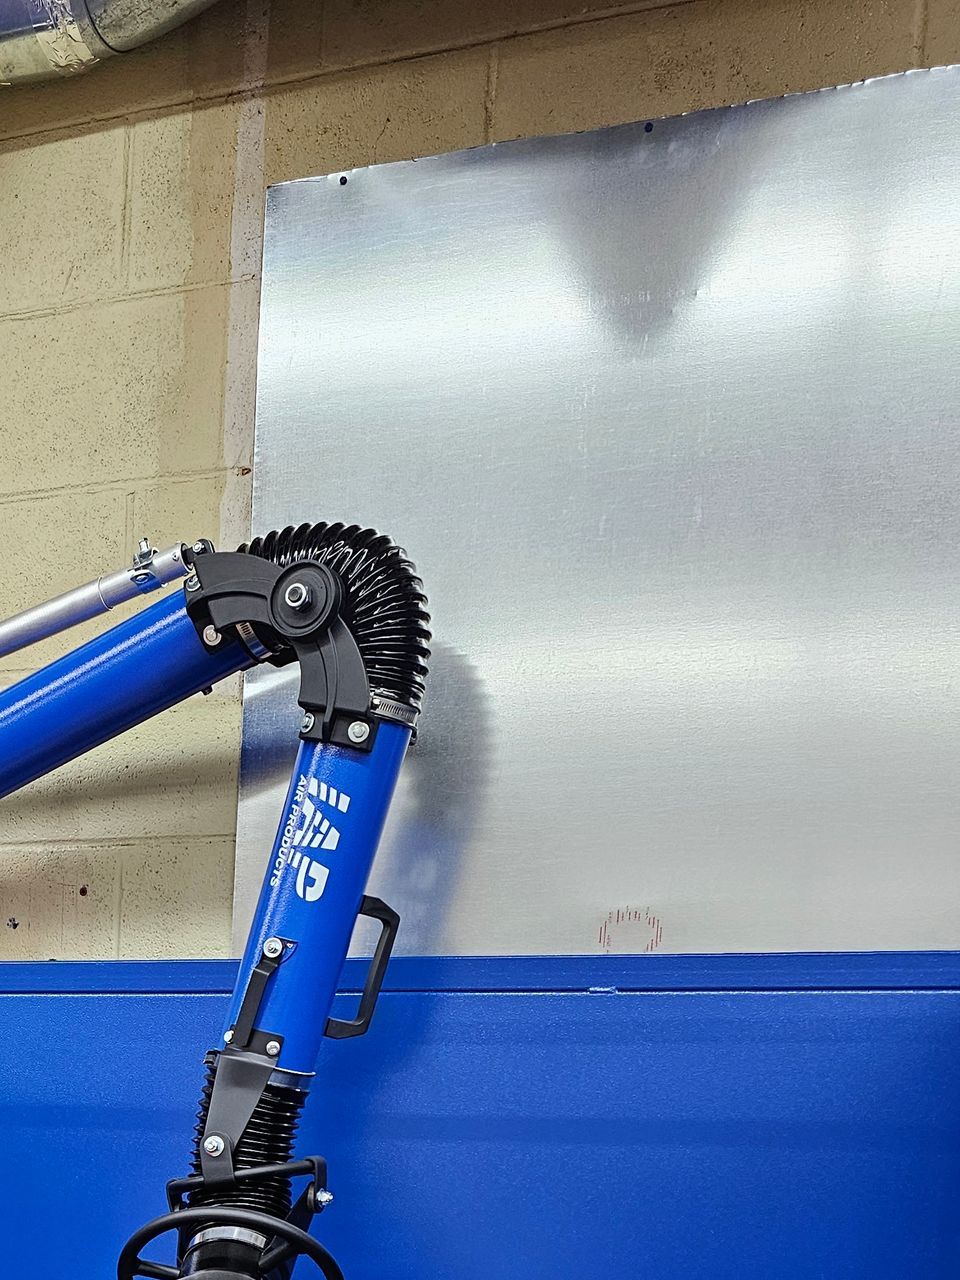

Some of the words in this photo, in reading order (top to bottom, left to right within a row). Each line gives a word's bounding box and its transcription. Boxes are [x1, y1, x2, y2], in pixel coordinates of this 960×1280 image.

[294, 774, 307, 802] AIR
[270, 804, 301, 888] PRODUCTS
[288, 777, 351, 902] IAP
